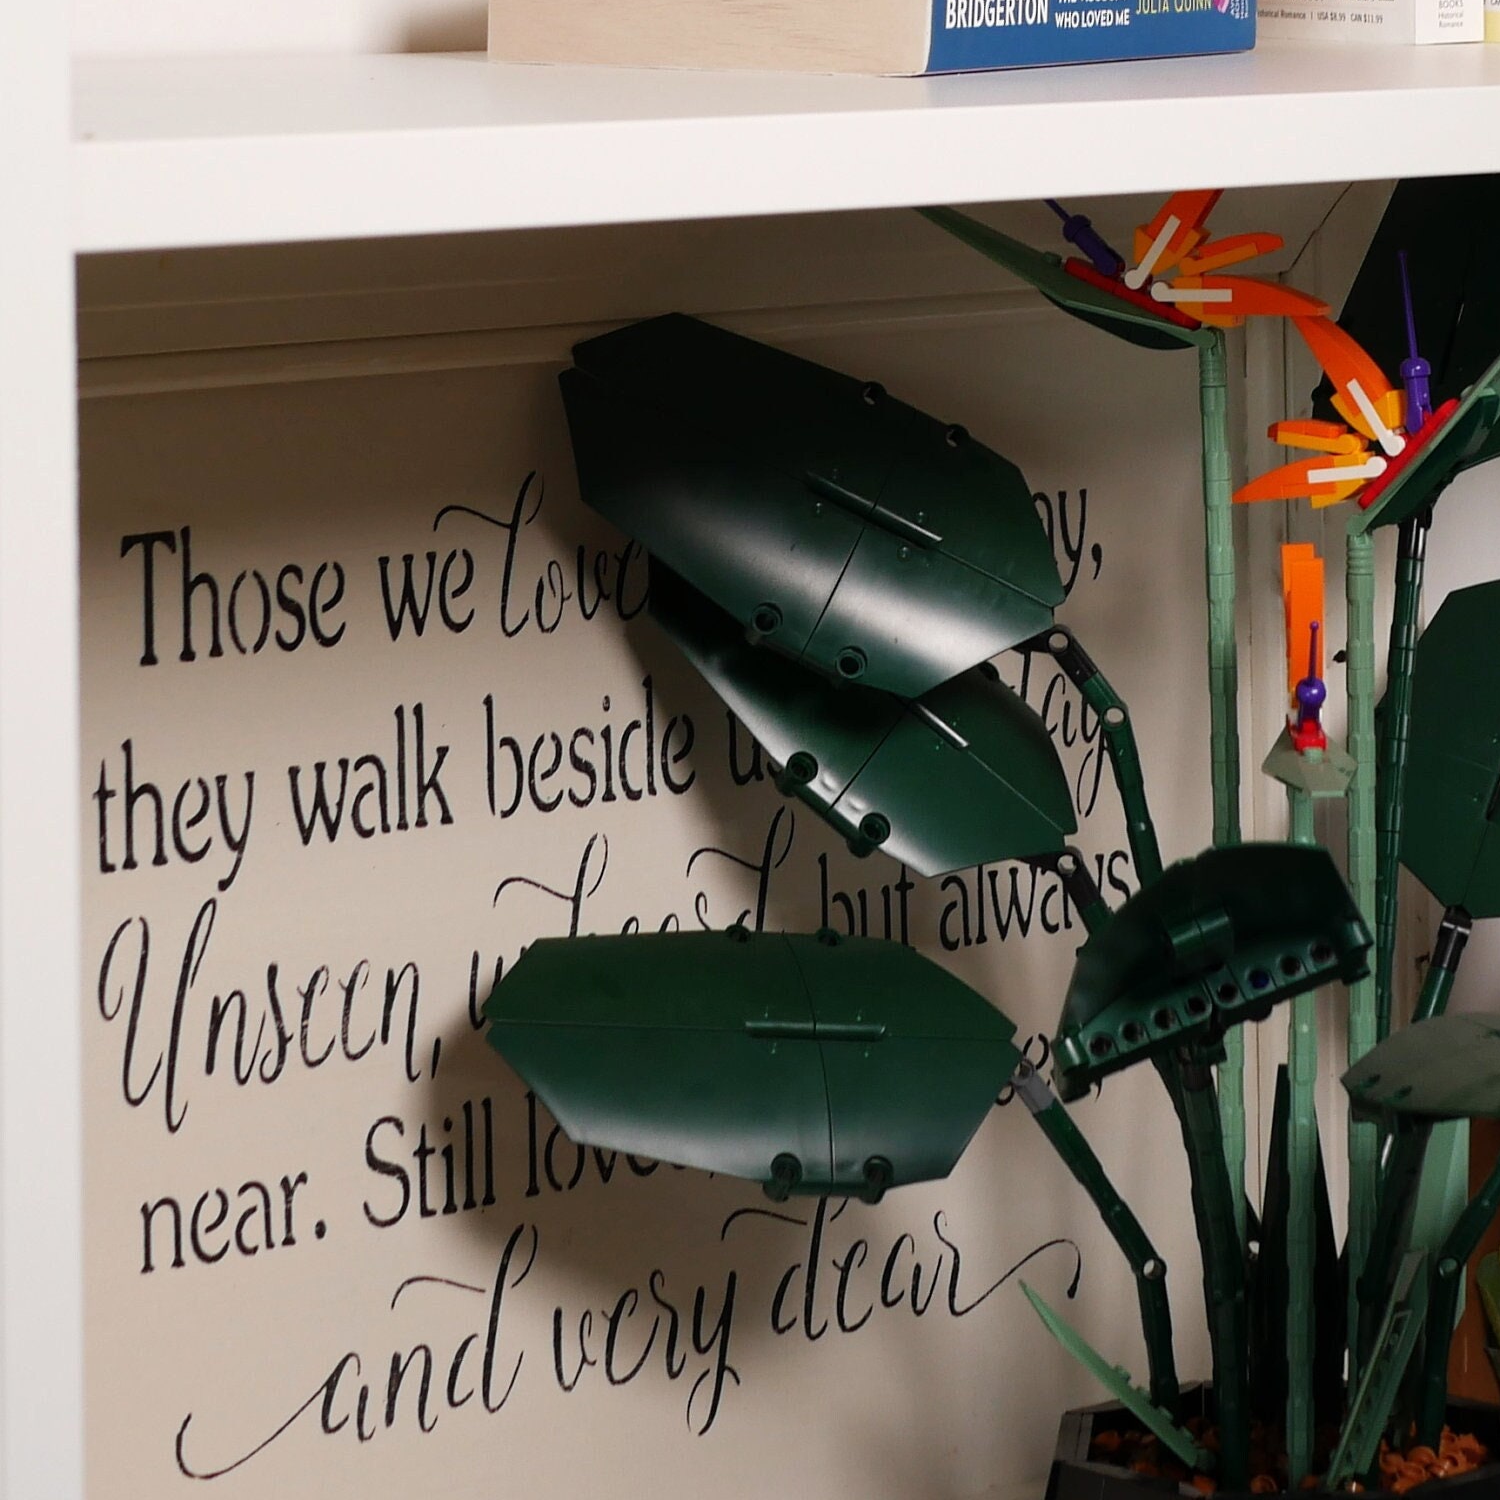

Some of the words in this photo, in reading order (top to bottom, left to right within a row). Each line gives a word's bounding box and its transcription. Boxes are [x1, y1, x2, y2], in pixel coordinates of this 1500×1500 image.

[1054, 11, 1080, 29] WHO
[1081, 9, 1114, 29] LOVED
[1115, 8, 1130, 27] ME
[120, 527, 348, 666] Those
[377, 544, 477, 645] we
[431, 470, 652, 639] love
[94, 740, 257, 892] they
[288, 703, 455, 845] walk
[482, 677, 697, 816] beside
[99, 896, 446, 1134] Unseen,
[818, 852, 915, 946] but
[138, 1169, 329, 1275] near.
[363, 1106, 498, 1229] Still
[175, 1223, 537, 1478] and
[551, 1261, 742, 1435] very
[720, 1195, 1082, 1342] dear
